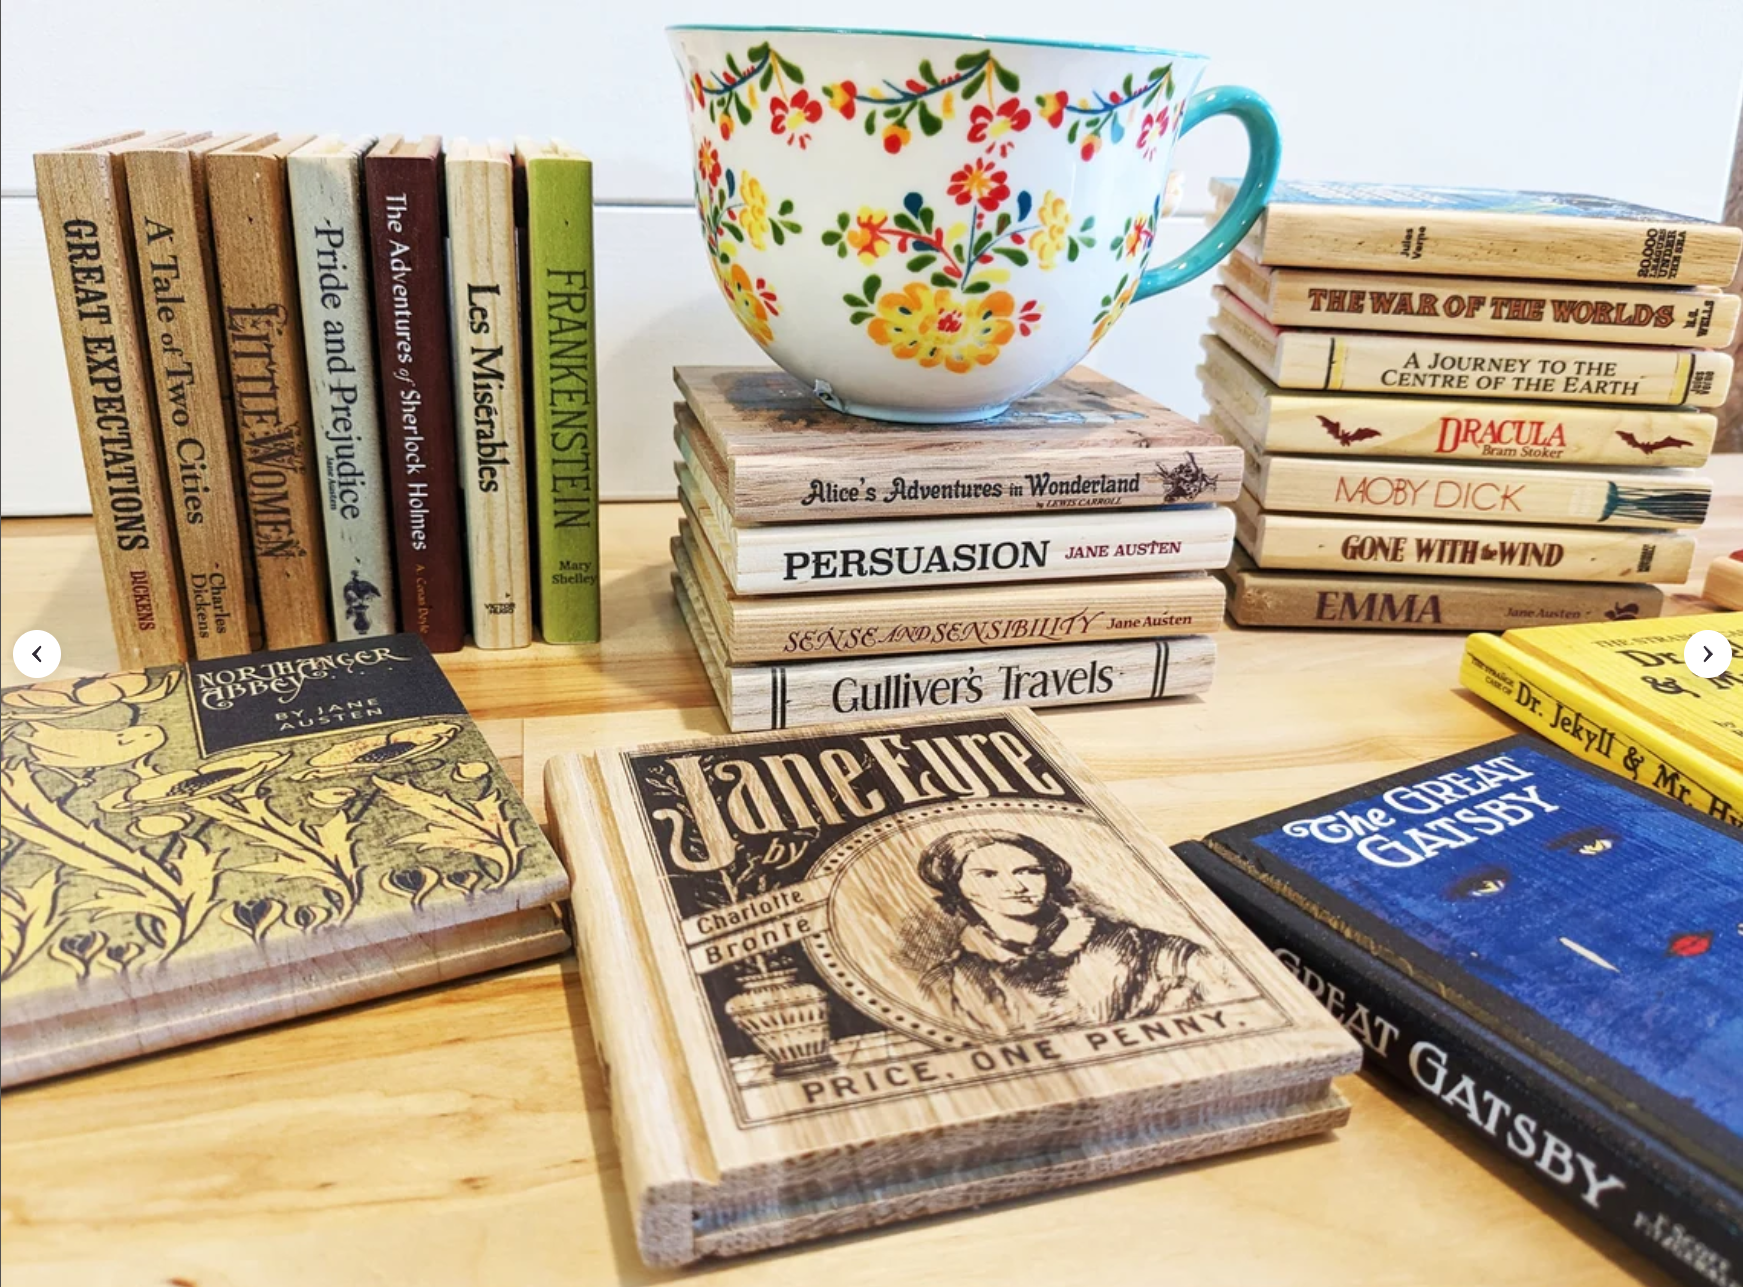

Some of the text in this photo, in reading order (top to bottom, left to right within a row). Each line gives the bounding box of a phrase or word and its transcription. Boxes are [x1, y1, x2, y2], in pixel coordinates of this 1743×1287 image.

[1400, 228, 1413, 258] Jules
[1411, 226, 1426, 260] Verne
[1308, 287, 1675, 328] THE WAR OF THE WORLDS
[1696, 300, 1714, 337] WELLS
[144, 216, 208, 526] A Tale of Two Cities
[314, 224, 367, 520] Pride and Prejudice
[386, 193, 429, 551] The Adventures of Sherlock Holmes
[1380, 368, 1640, 397] CENTRE OF THE EARTH
[1404, 351, 1617, 377] A JOURNEY TO THE
[63, 219, 150, 552] GREAT EXPECTATIONS
[467, 283, 510, 494] Les Misérables
[547, 268, 592, 530] FRANKENSTEIN
[1435, 416, 1566, 453] DRACULA
[1482, 444, 1563, 459] Bram Stoker
[244, 420, 307, 557] WOMEN
[801, 472, 1141, 506] Alice's Adventures in Wonderland
[1046, 498, 1077, 508] LEWIS
[1078, 497, 1123, 507] CARROLL
[1335, 476, 1527, 512] MOBY DICK
[559, 560, 592, 573] Mary
[783, 540, 1050, 581] PERSUASION
[1065, 540, 1182, 560] JANE AUSTEN
[1341, 534, 1406, 562] GONE
[1415, 538, 1477, 565] WITH
[1498, 540, 1564, 568] WIND
[551, 573, 598, 586] Shelley
[130, 570, 155, 631] DICKENS
[191, 573, 211, 638] Dickens
[209, 573, 230, 634] Charles
[1314, 590, 1442, 624] EMMA
[1505, 606, 1582, 620] Jane Austen
[783, 607, 1105, 654] SENSE AND SENSIBILITY
[1106, 612, 1192, 630] Jane Austen
[197, 647, 413, 689] NORTHANGER
[201, 674, 304, 711] ABBEY
[832, 661, 1114, 713] Gulliver's Travels
[275, 697, 380, 721] BY JANE
[279, 708, 383, 731] AUSTEN
[1514, 681, 1543, 717] Dr.
[1550, 702, 1615, 758] Jekyll
[1622, 746, 1645, 780] &
[1652, 763, 1693, 806] Mr.
[651, 730, 1066, 873] Jane Eyre
[1282, 756, 1535, 844] The GREAT
[1357, 785, 1558, 869] GATSBY
[761, 836, 811, 870] by
[696, 891, 805, 935] Charlotte
[971, 1038, 1063, 1073] ONE
[1408, 1040, 1627, 1209] GATSBY
